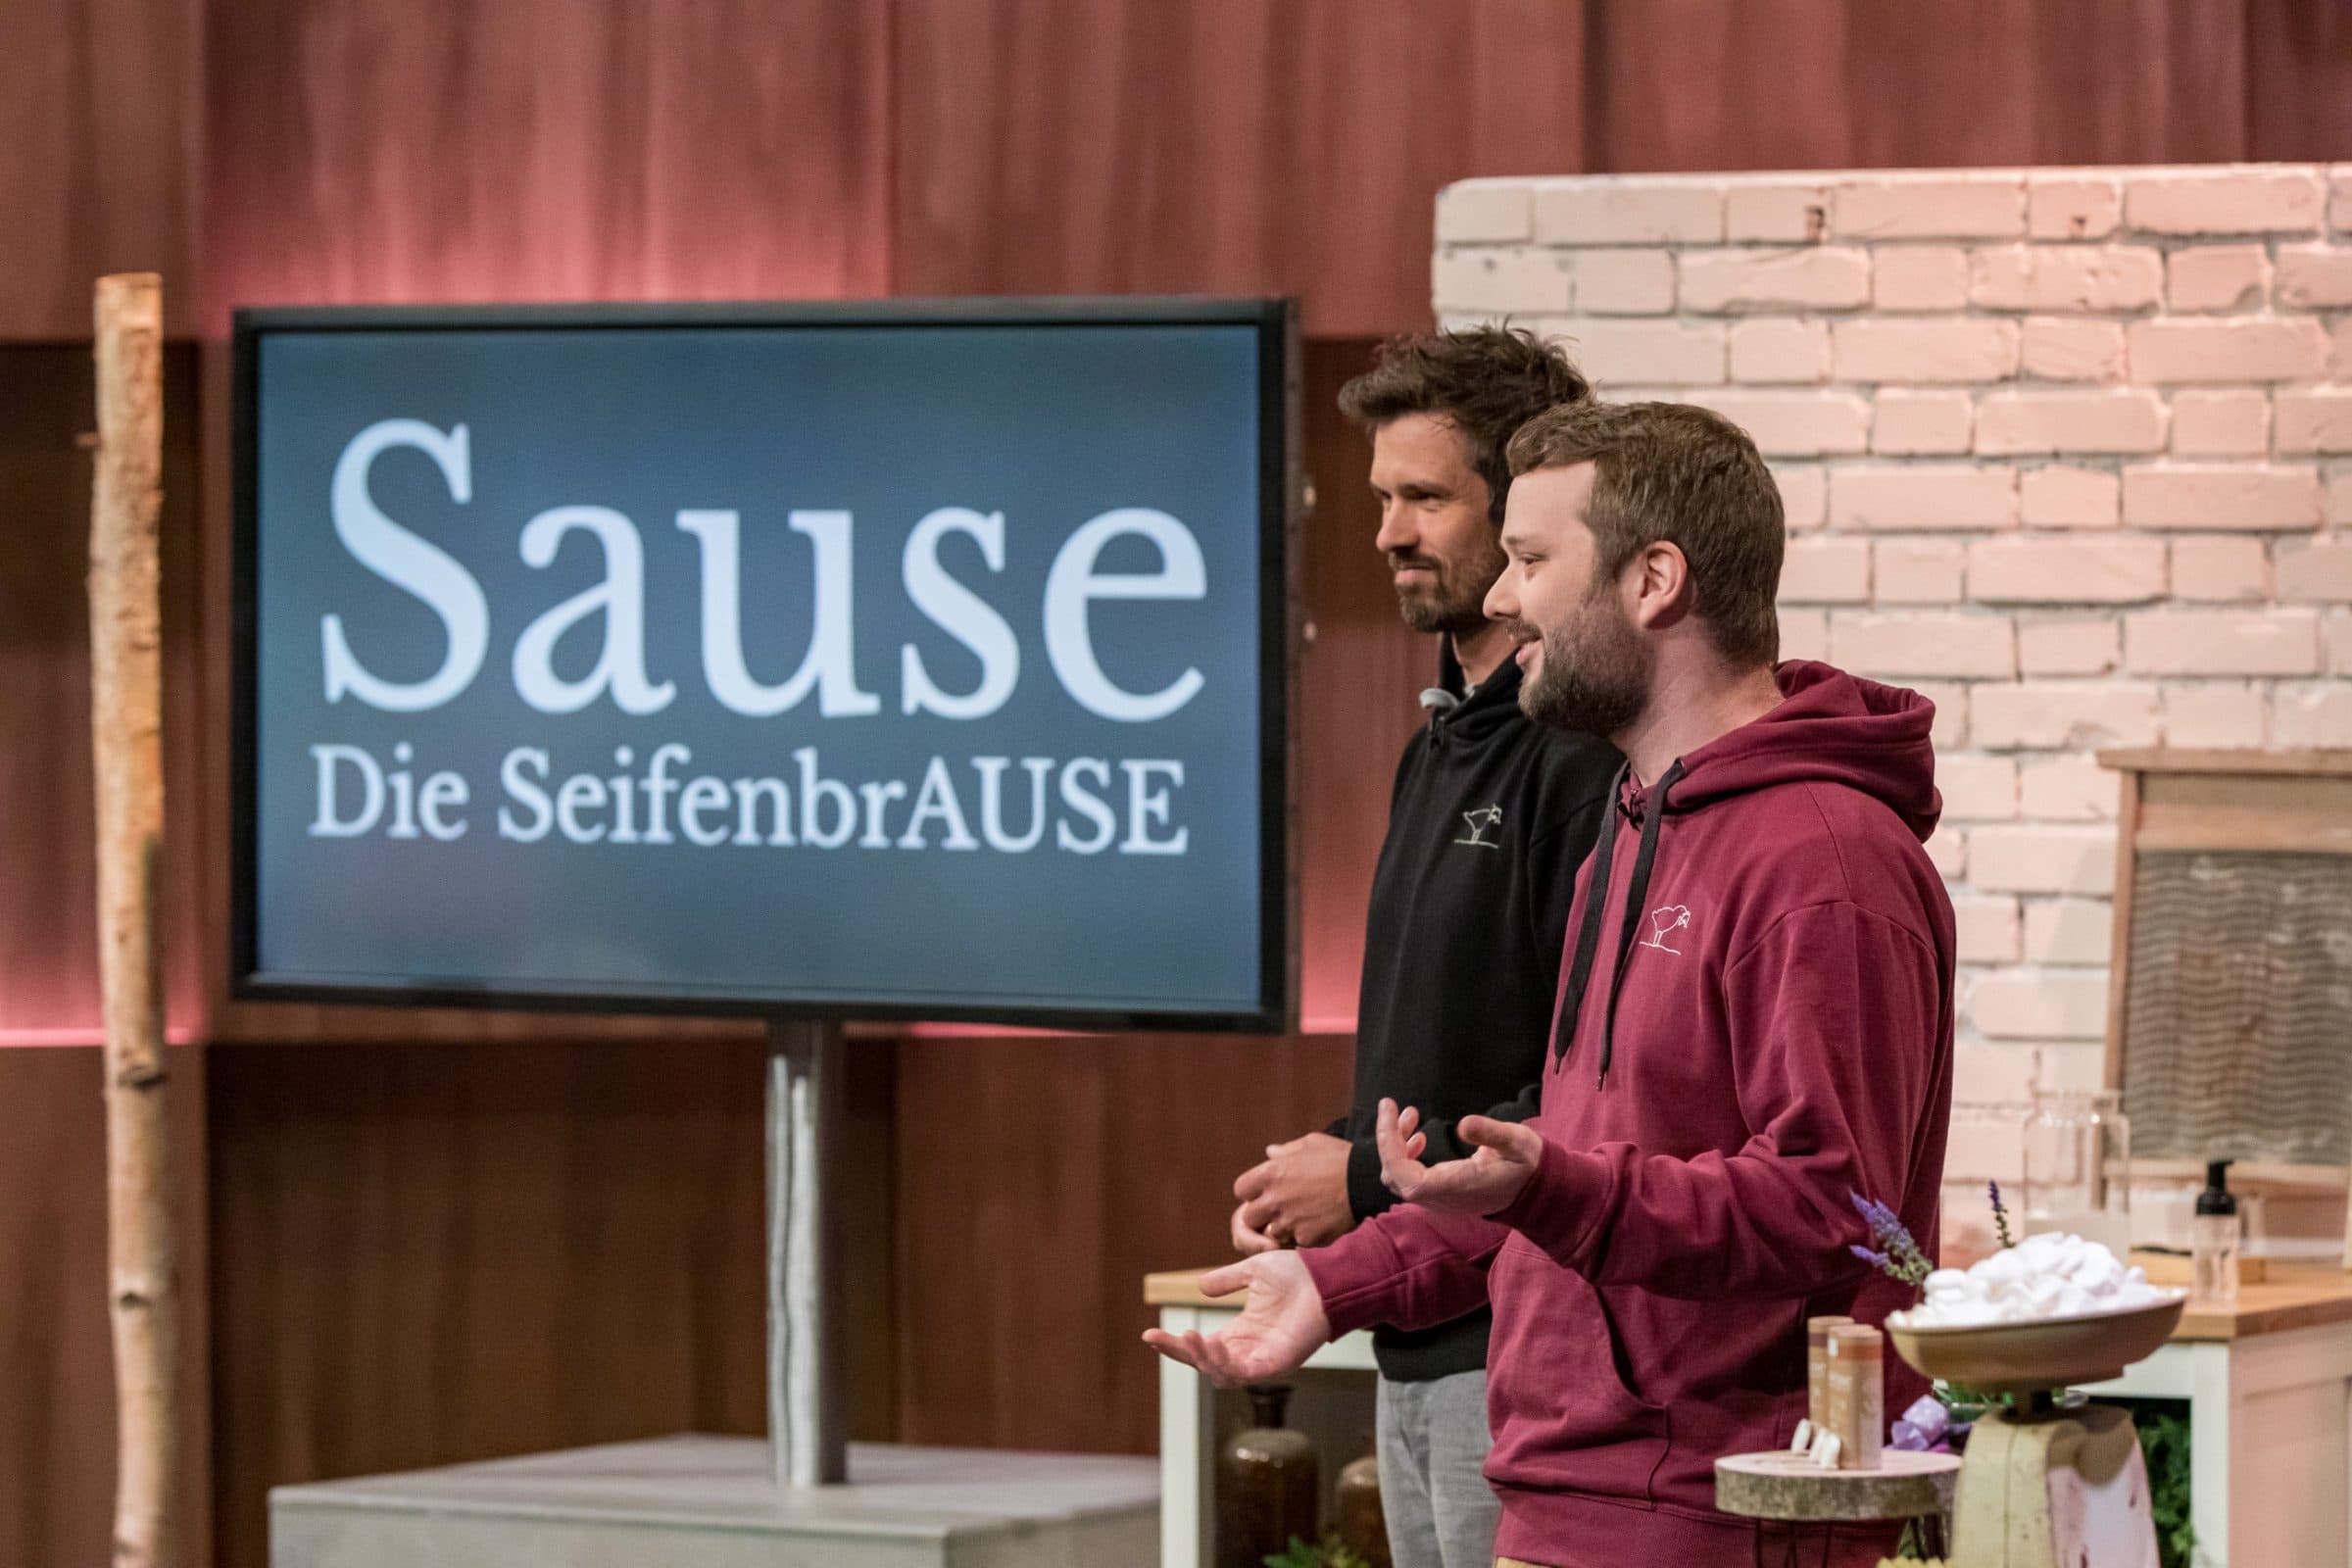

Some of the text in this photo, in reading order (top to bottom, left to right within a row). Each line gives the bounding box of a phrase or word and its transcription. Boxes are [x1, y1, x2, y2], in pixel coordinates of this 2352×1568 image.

[320, 417, 1207, 723] Sause
[308, 742, 1189, 855] Die SeifenbrAUSE
